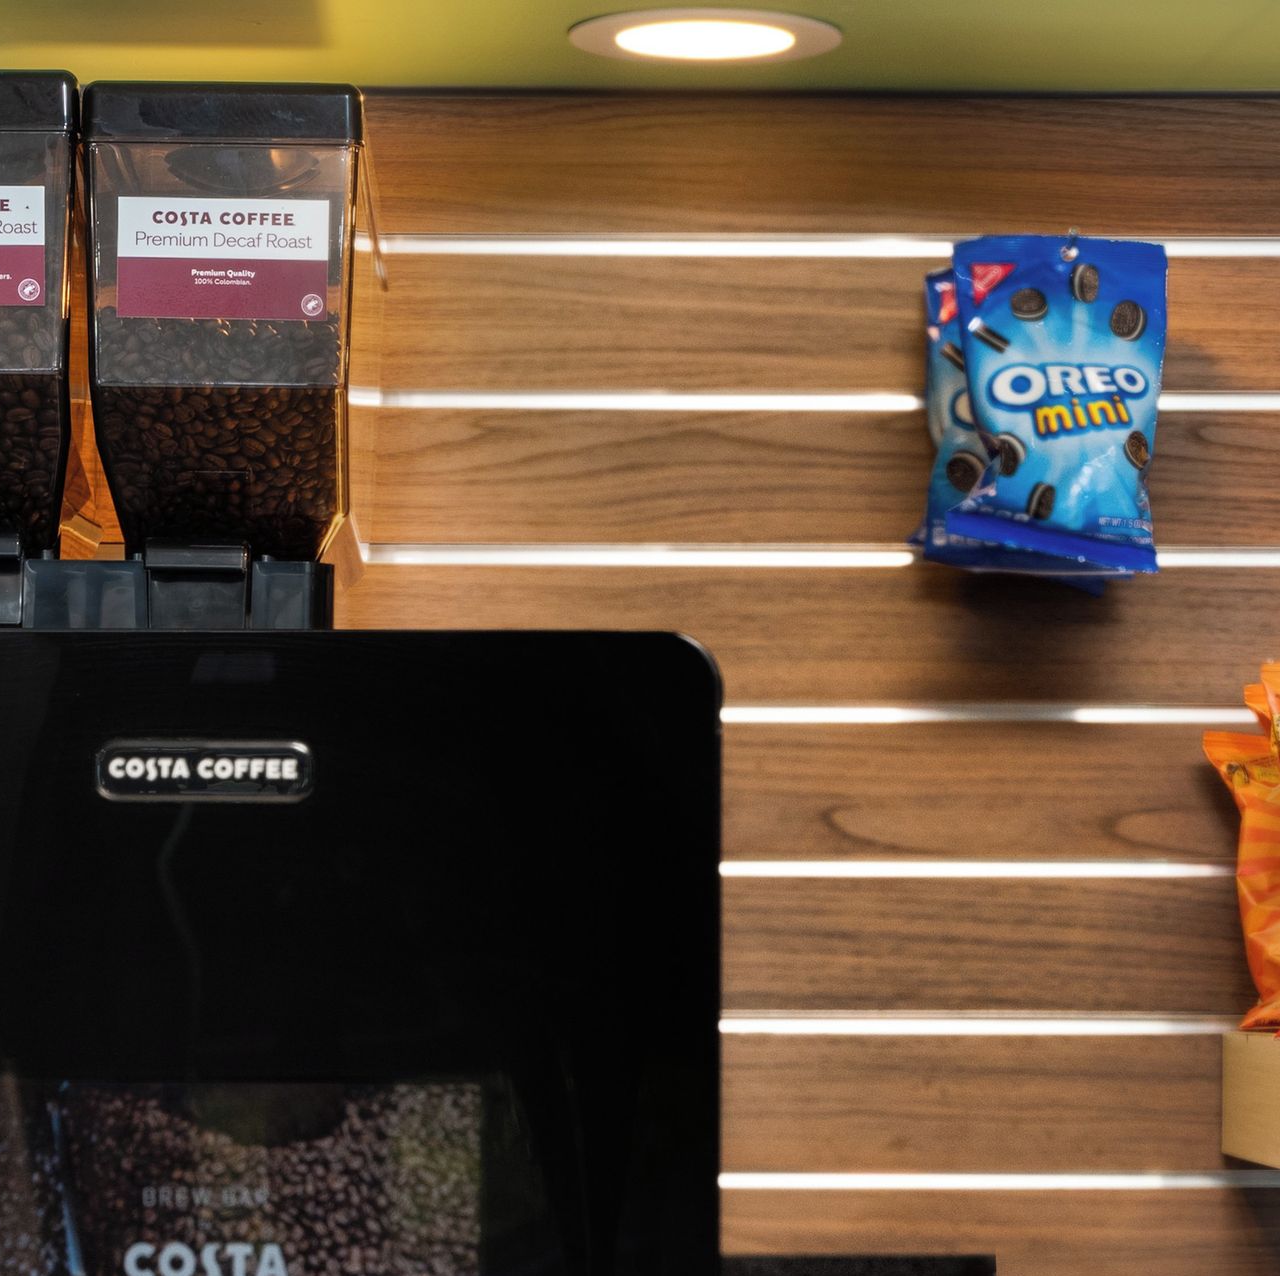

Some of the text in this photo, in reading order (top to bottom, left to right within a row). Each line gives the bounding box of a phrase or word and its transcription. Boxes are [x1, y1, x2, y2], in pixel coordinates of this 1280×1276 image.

[152, 211, 295, 226] COSTA COFFEE
[135, 231, 312, 249] Premium Decaf Roast
[191, 269, 255, 278] Premium Quality
[992, 365, 1146, 406] OREO
[1037, 396, 1129, 435] mini
[109, 756, 298, 781] COSTA COFFEE
